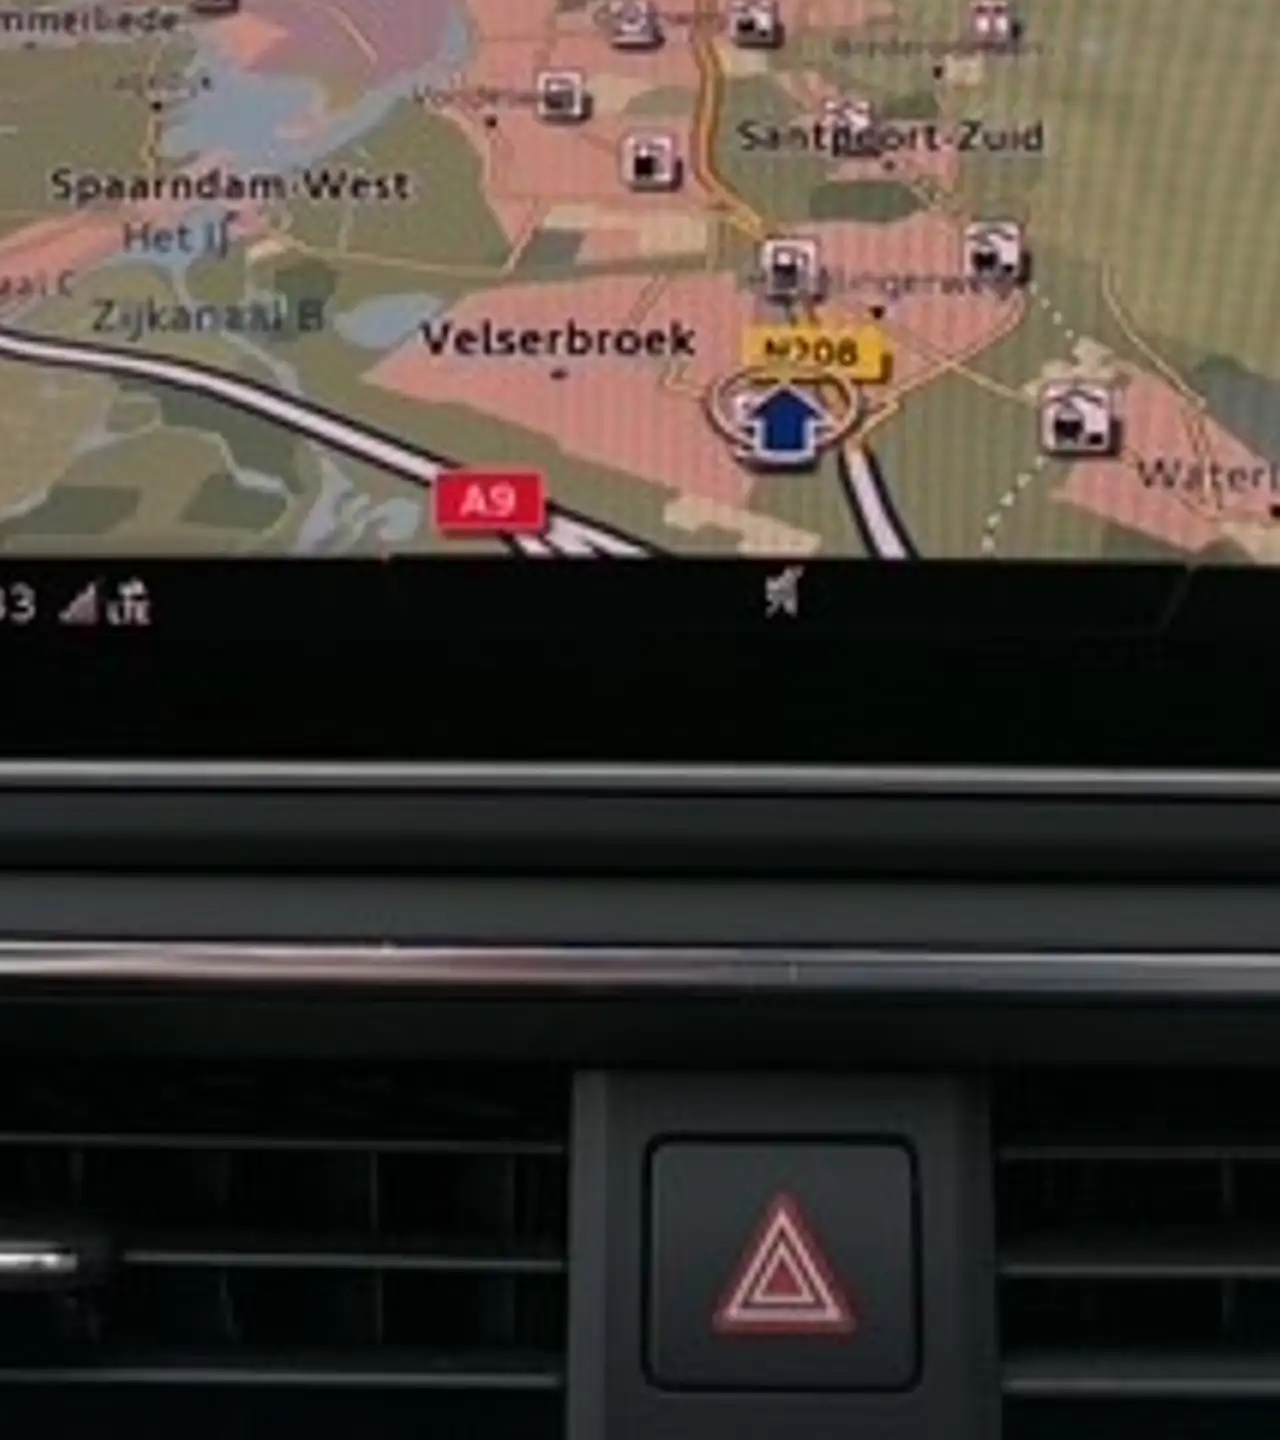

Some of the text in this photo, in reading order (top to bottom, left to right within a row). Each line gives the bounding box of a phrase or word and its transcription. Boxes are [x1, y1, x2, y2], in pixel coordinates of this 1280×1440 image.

[122, 220, 191, 253] Het
[91, 298, 283, 342] Zijkanaal
[419, 320, 698, 357] Velserbroek
[458, 483, 518, 517] A9
